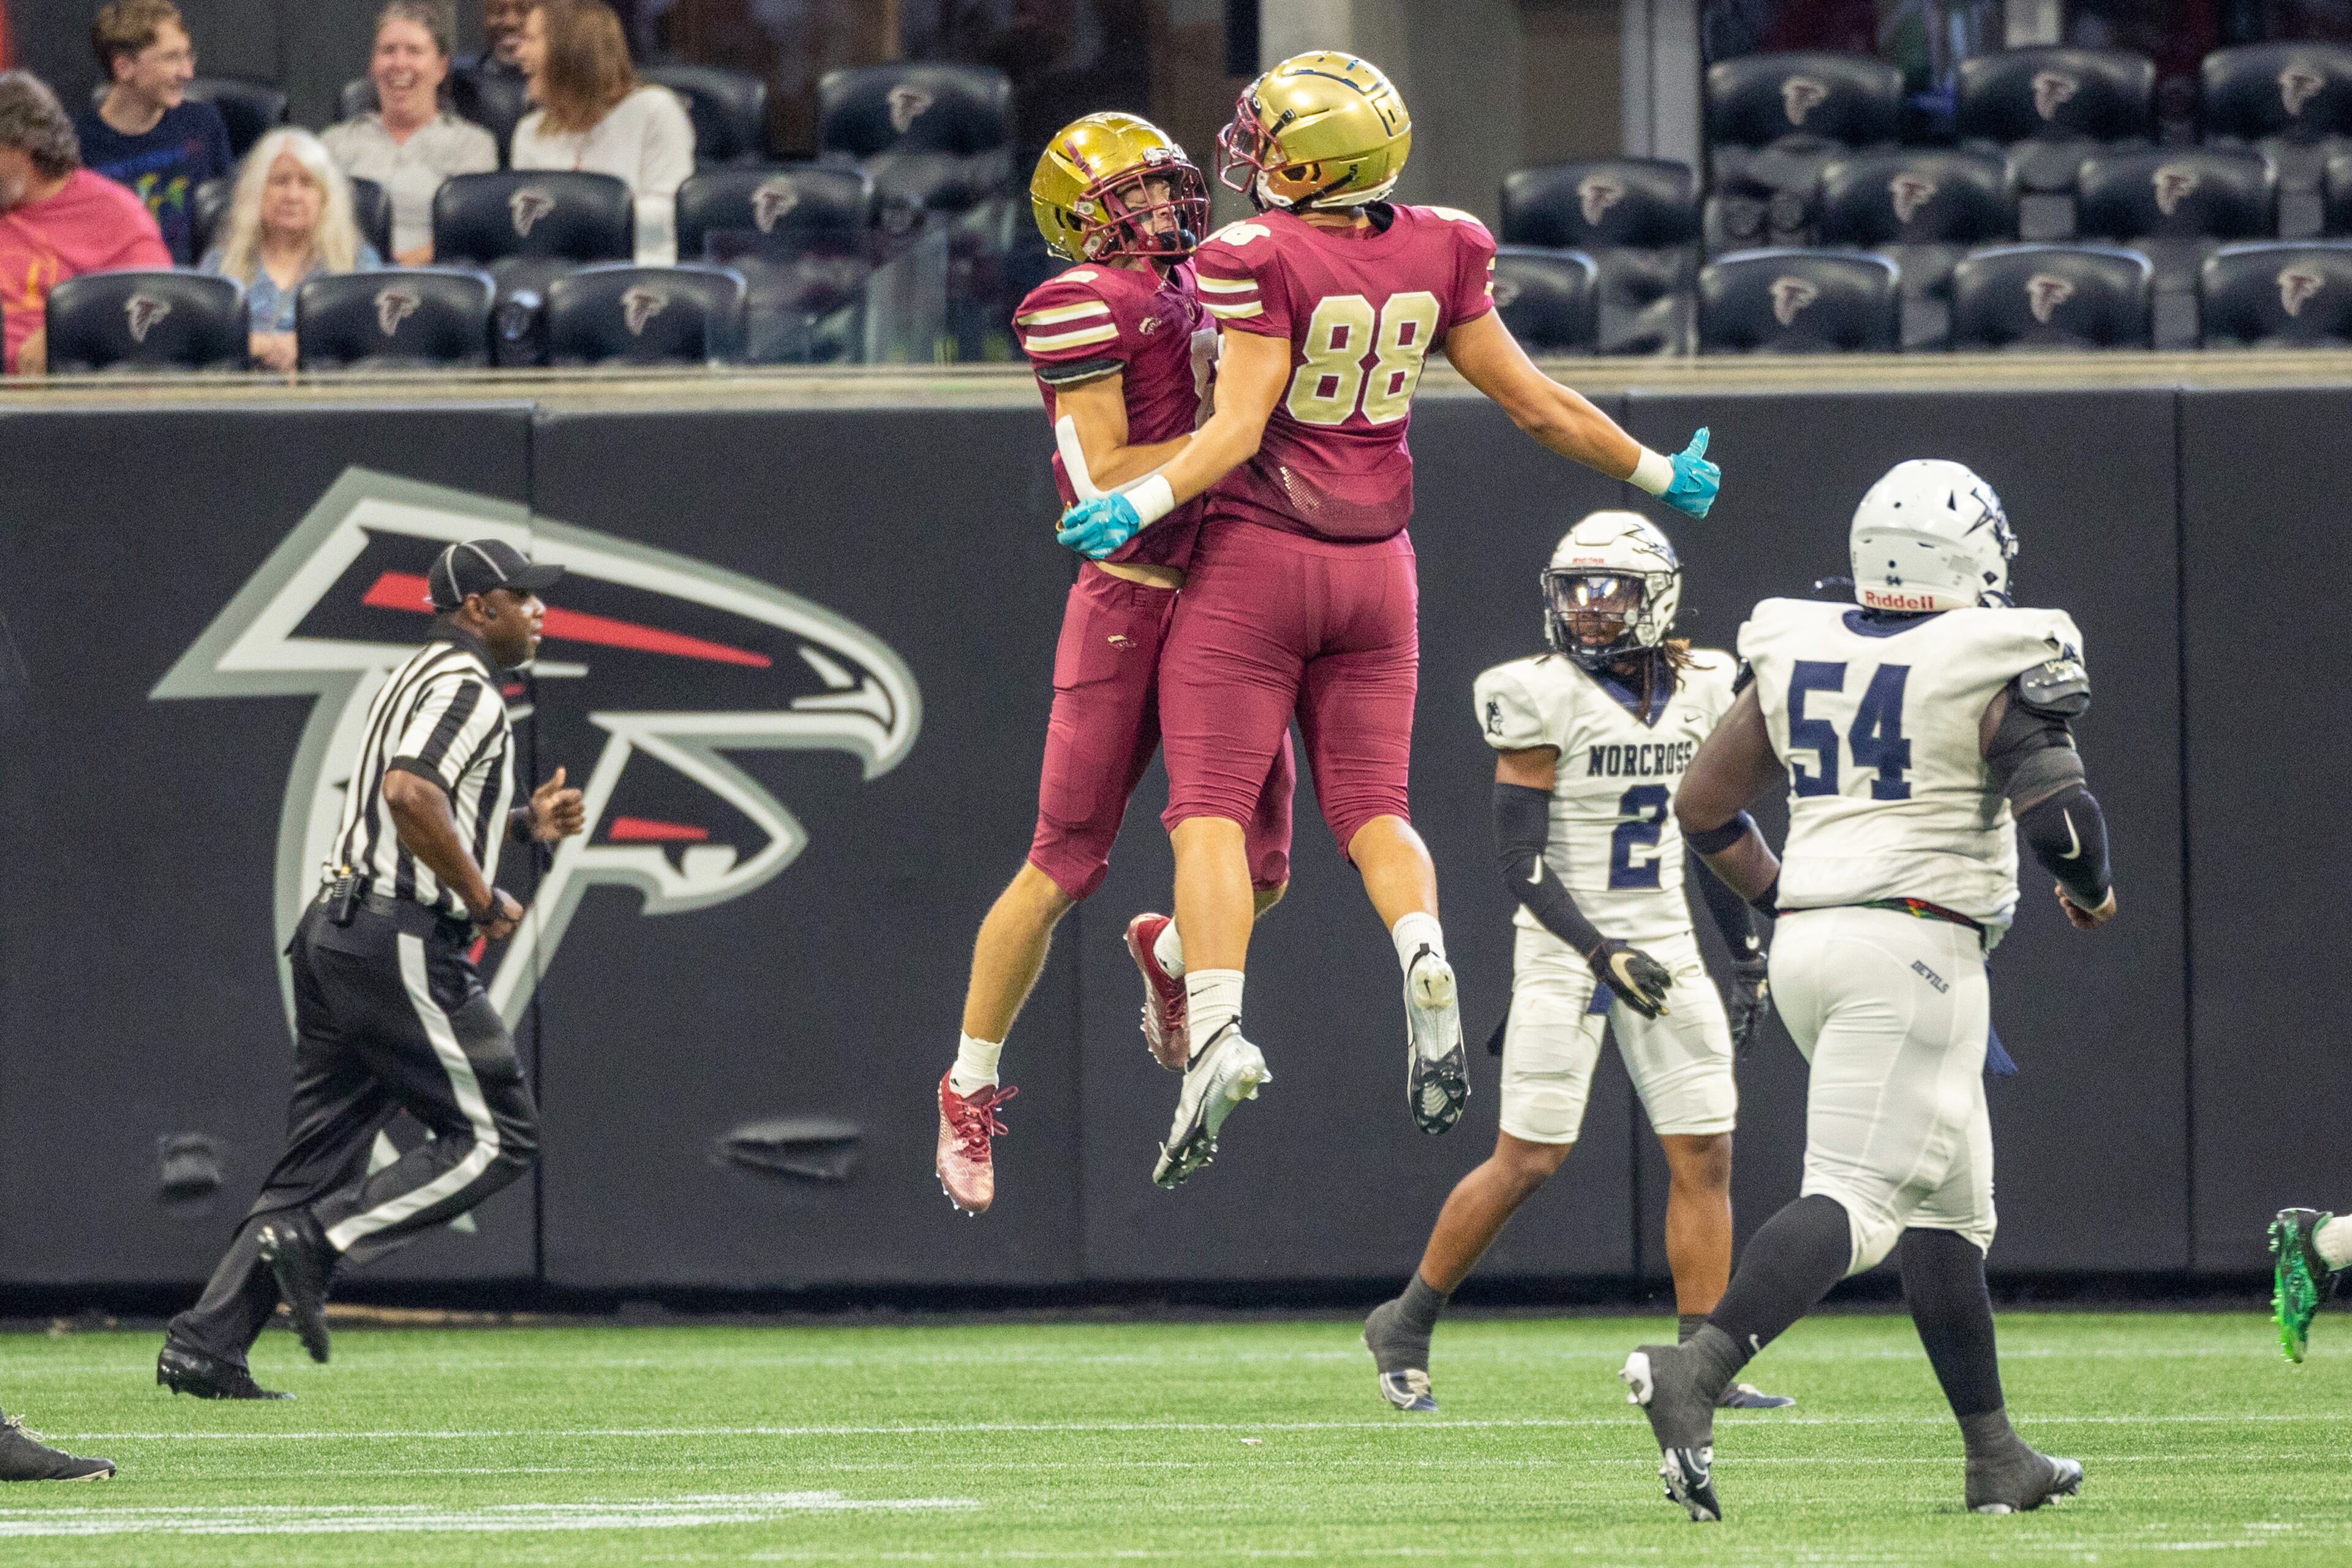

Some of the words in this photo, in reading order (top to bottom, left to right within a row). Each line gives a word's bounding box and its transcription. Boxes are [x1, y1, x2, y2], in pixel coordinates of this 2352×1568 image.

[1286, 291, 1440, 425] 88
[1865, 591, 1934, 609] Riddell
[1586, 741, 1692, 777] NORCROSS
[1787, 660, 1912, 801] 54
[1607, 783, 1671, 890] 2
[1910, 959, 1949, 993] DEVILS
